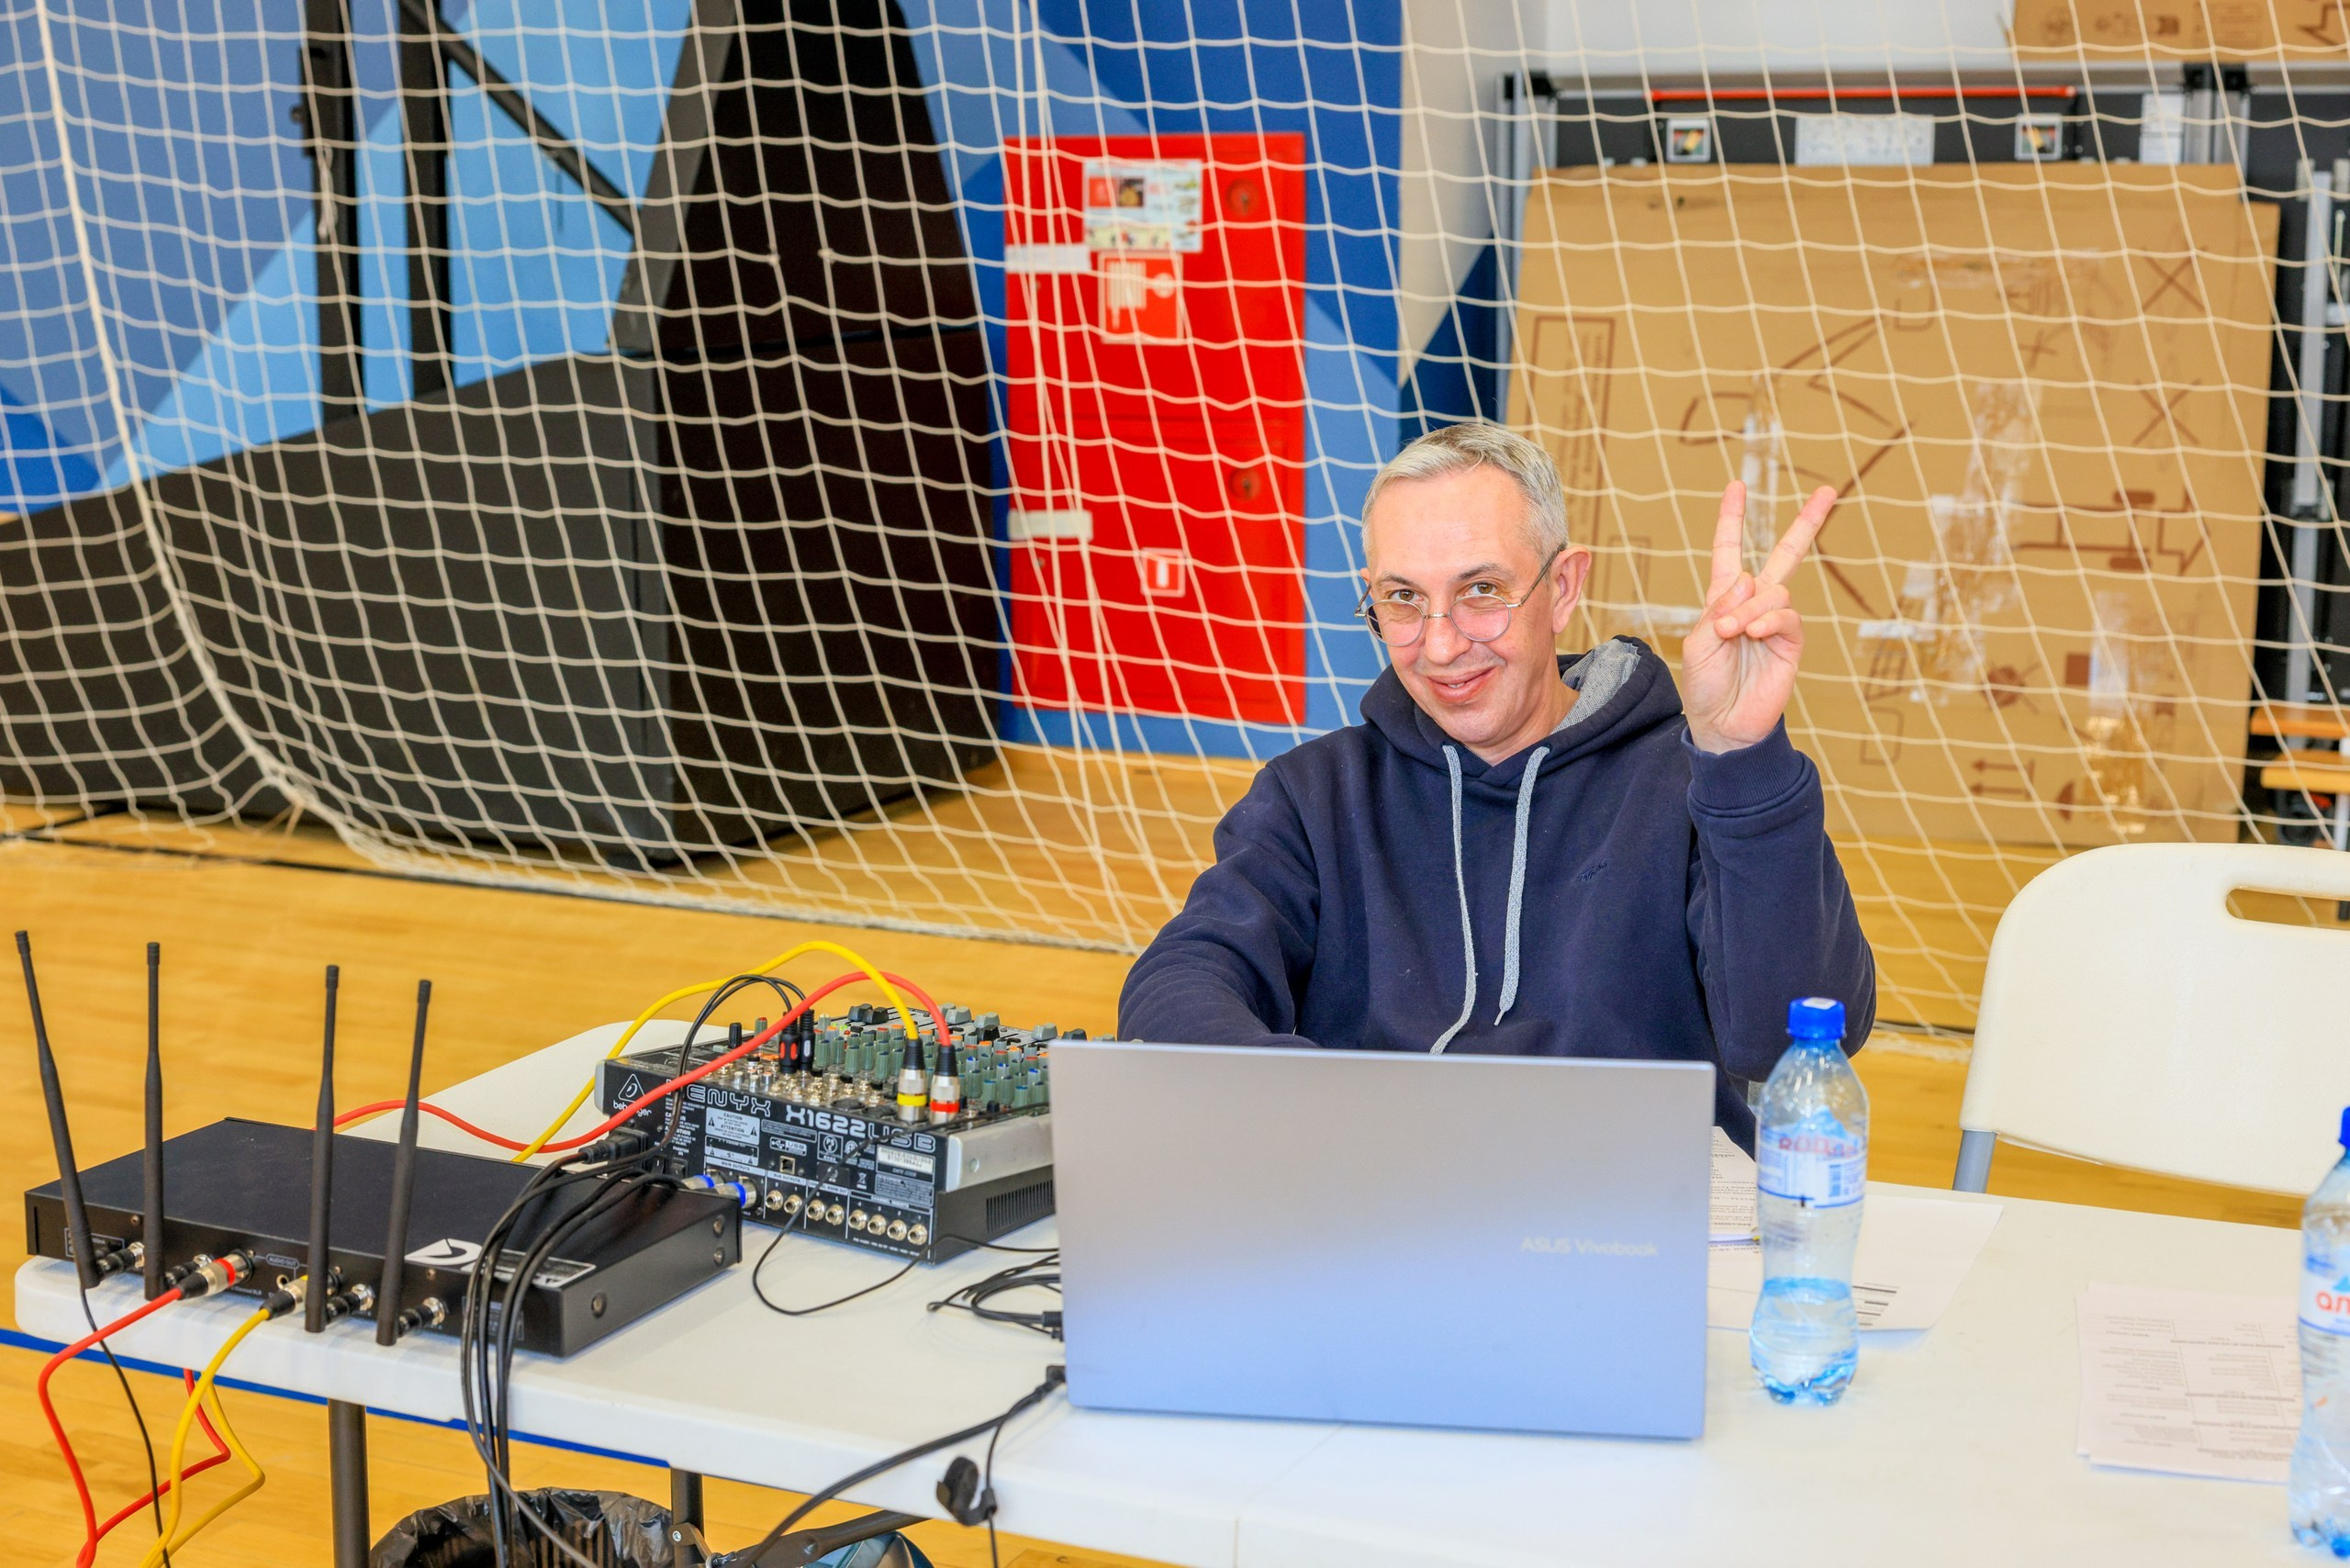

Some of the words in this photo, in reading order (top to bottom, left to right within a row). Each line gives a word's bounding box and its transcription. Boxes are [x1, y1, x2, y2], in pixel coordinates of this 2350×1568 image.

[613, 1100, 653, 1117] behger
[723, 1113, 743, 1121] CAUTION
[1520, 1238, 1572, 1255] ASUS
[1574, 1238, 1660, 1257] Vivobook
